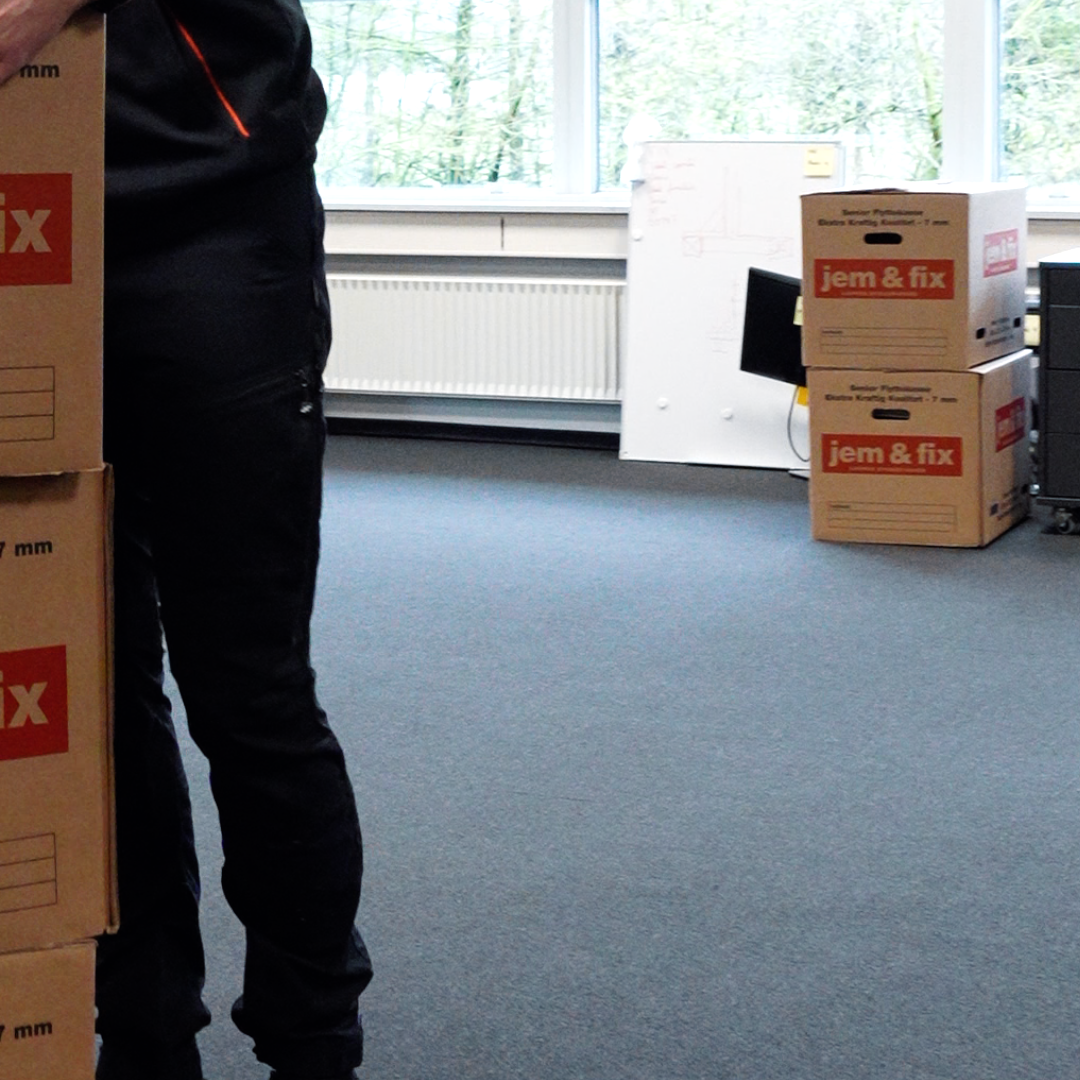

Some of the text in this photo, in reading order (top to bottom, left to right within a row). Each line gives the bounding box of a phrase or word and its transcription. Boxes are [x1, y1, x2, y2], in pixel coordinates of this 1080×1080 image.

[821, 264, 946, 292] jem & fix
[828, 440, 954, 467] jem & fix
[14, 537, 54, 557] mm
[14, 1020, 54, 1040] mm
